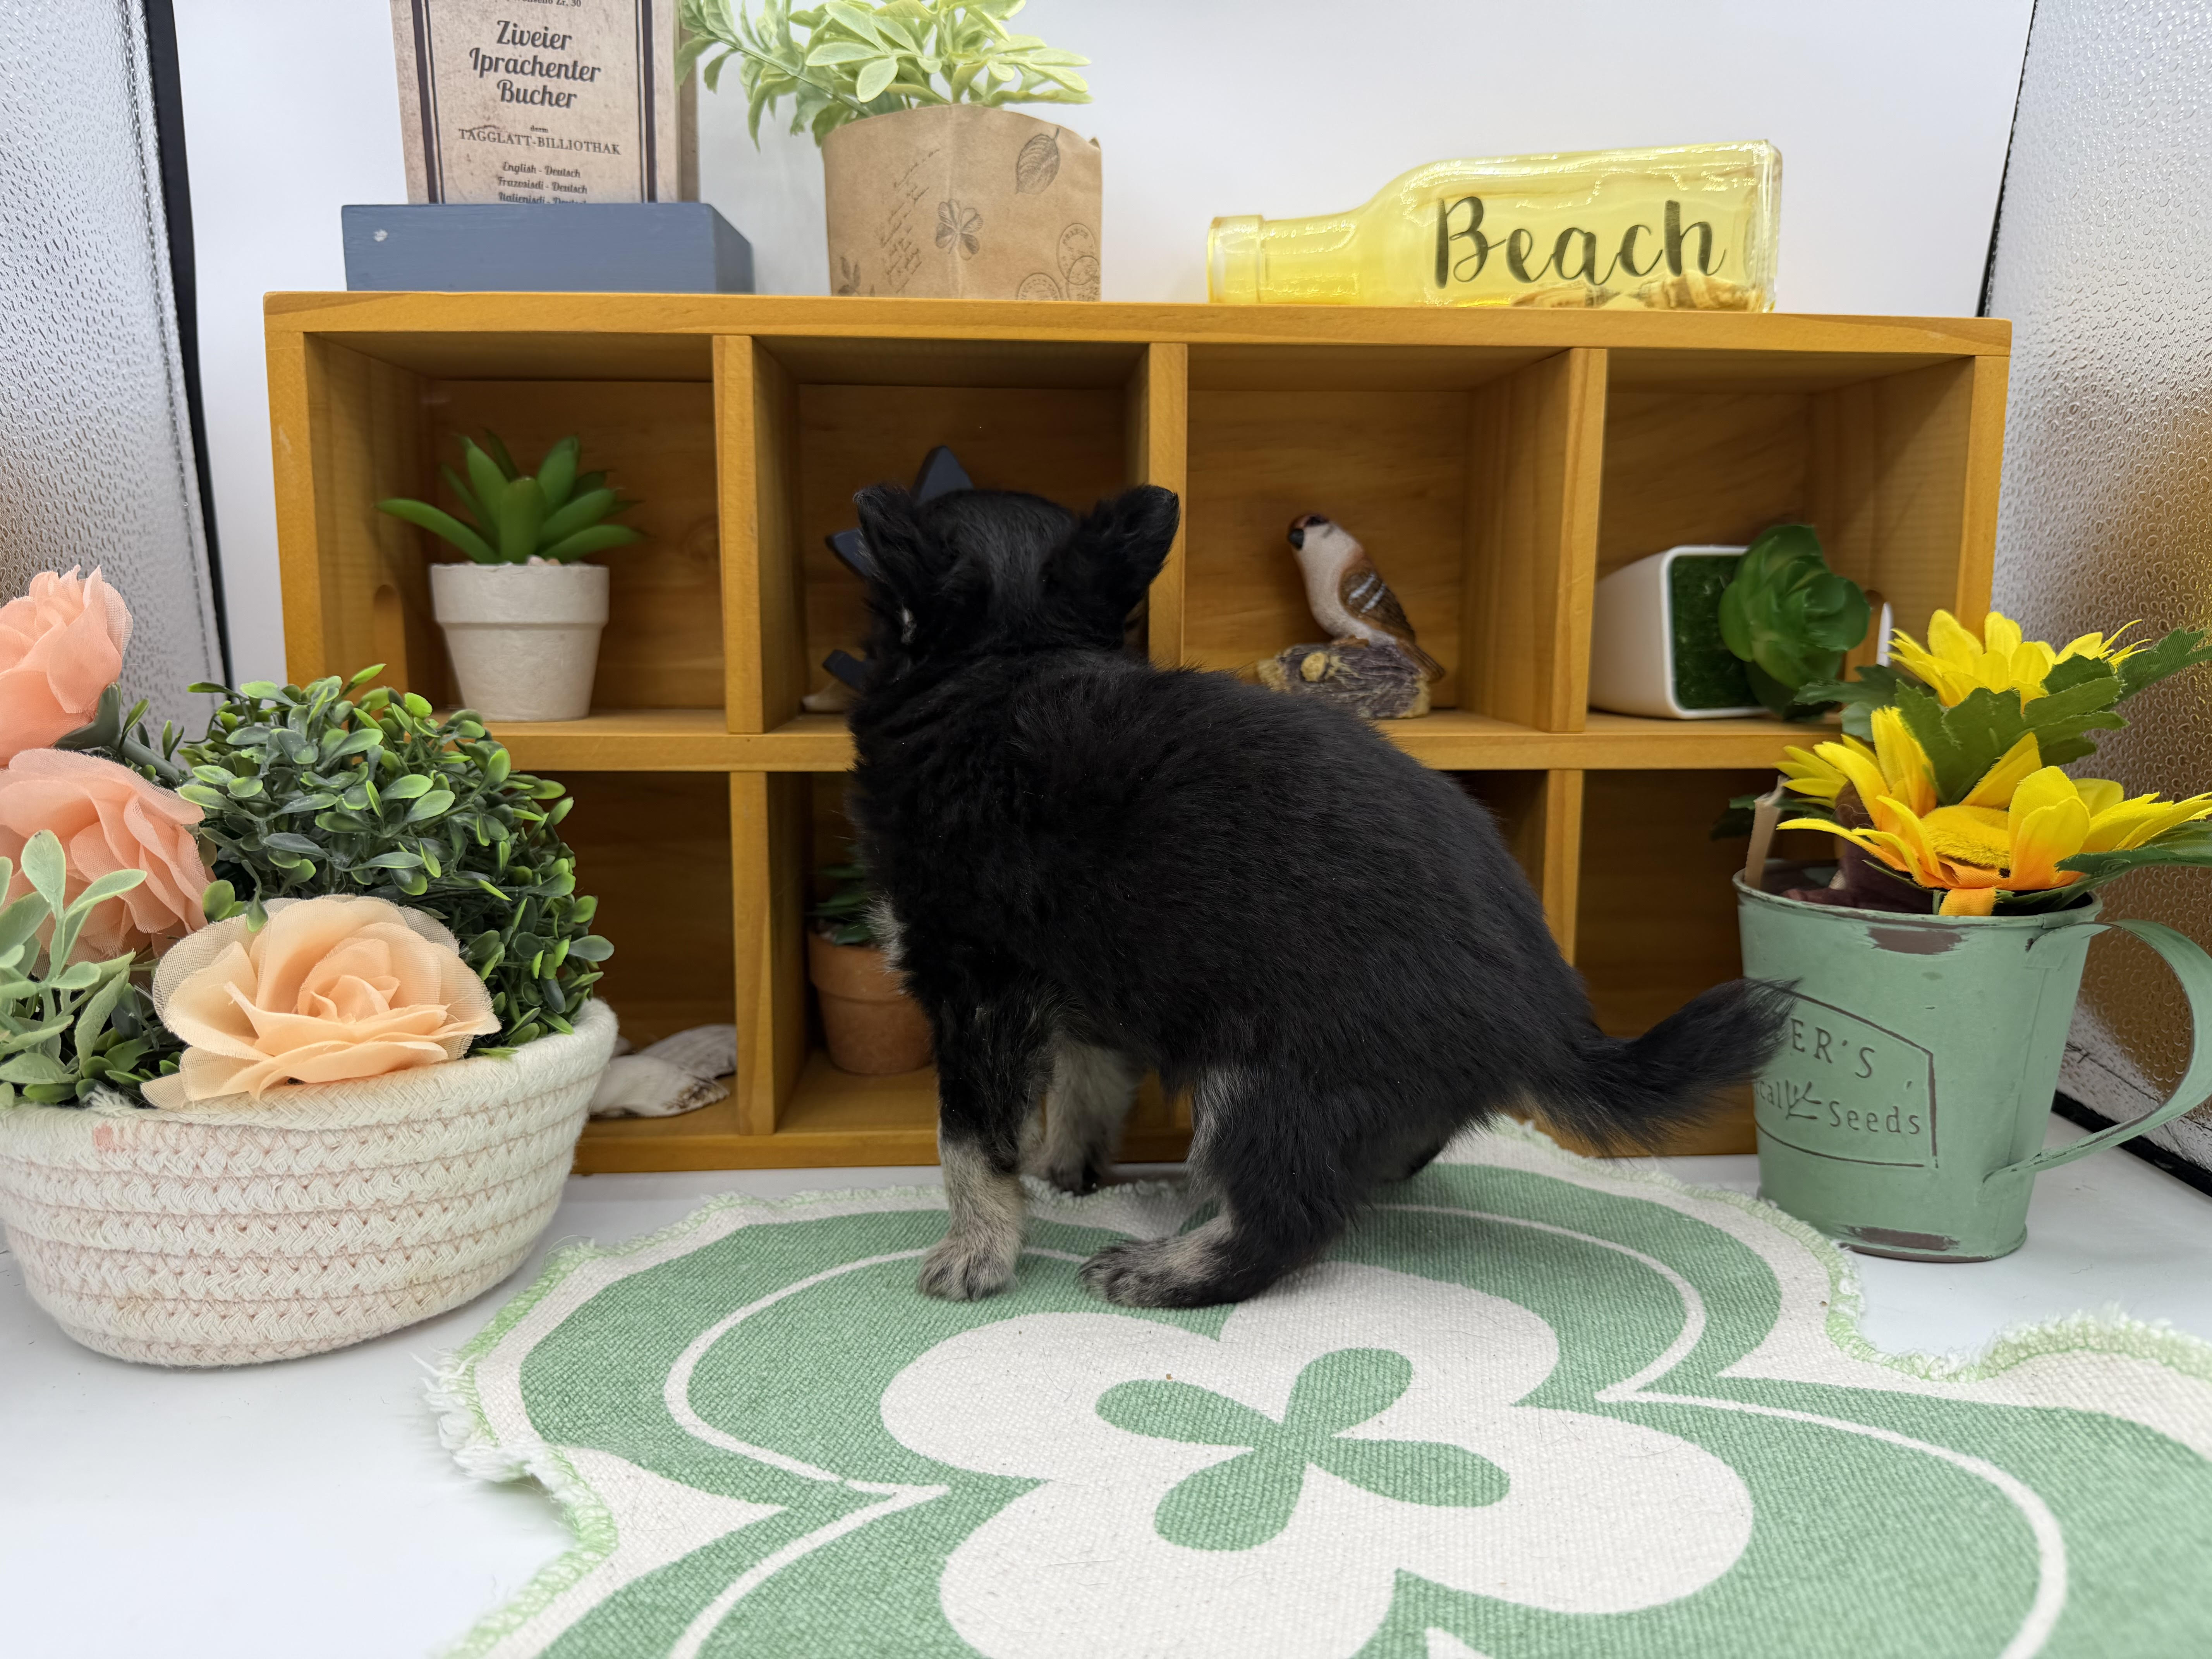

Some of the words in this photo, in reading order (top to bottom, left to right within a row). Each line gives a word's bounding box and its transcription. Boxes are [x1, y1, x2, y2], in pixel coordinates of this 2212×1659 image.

[469, 47, 601, 82] Iprachenter
[496, 79, 578, 109] Bucher
[503, 161, 536, 174] English
[544, 165, 580, 178] Deutsch
[552, 181, 587, 194] Deutsch
[1434, 195, 1727, 289] Beach
[1790, 1017, 1875, 1078] ER'S
[1756, 1079, 1822, 1120] cally
[1829, 1100, 1920, 1135] Seeds
